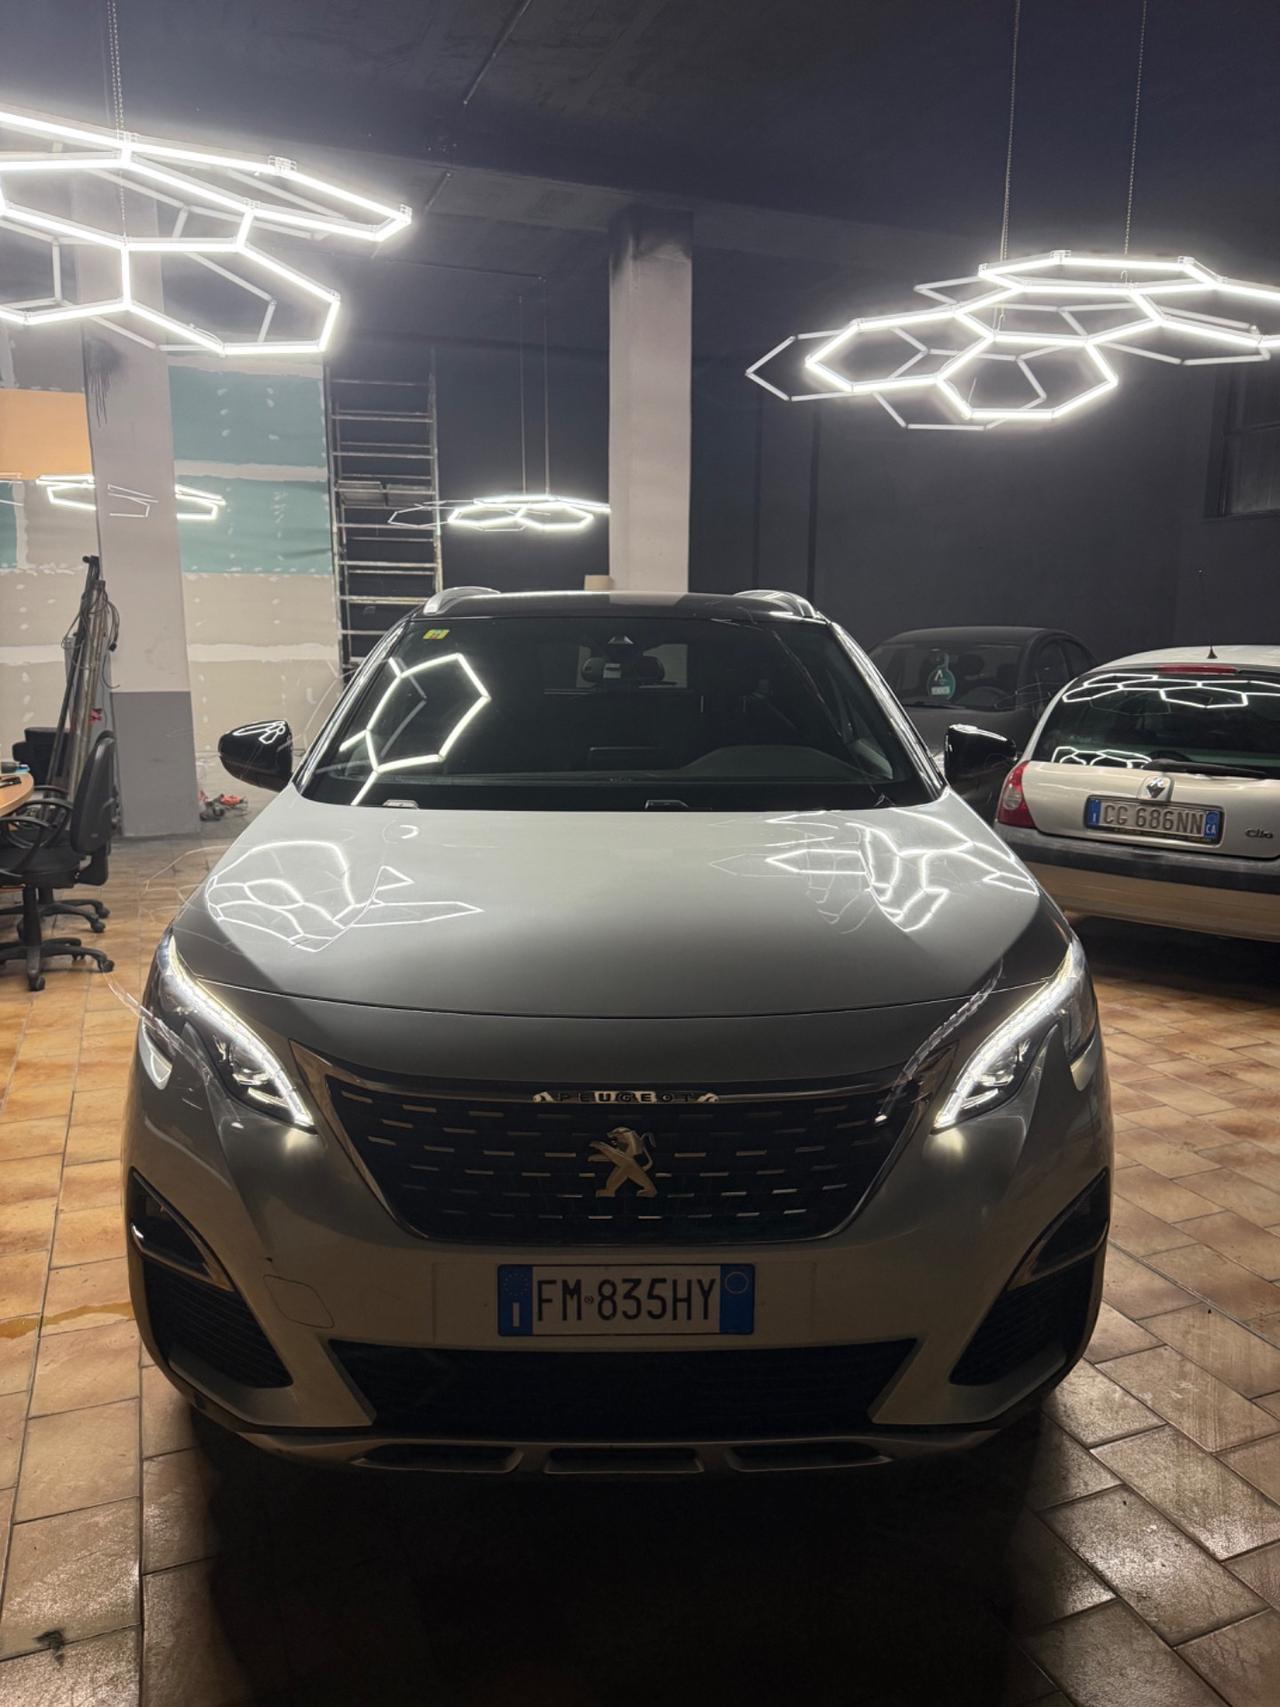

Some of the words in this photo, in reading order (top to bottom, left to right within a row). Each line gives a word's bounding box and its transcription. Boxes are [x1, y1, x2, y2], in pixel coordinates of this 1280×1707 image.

[1103, 804, 1128, 826] CG
[1135, 807, 1204, 835] 686NN
[1206, 824, 1217, 835] CA
[1245, 829, 1274, 839] Clio
[557, 1090, 693, 1103] PEUGEOT
